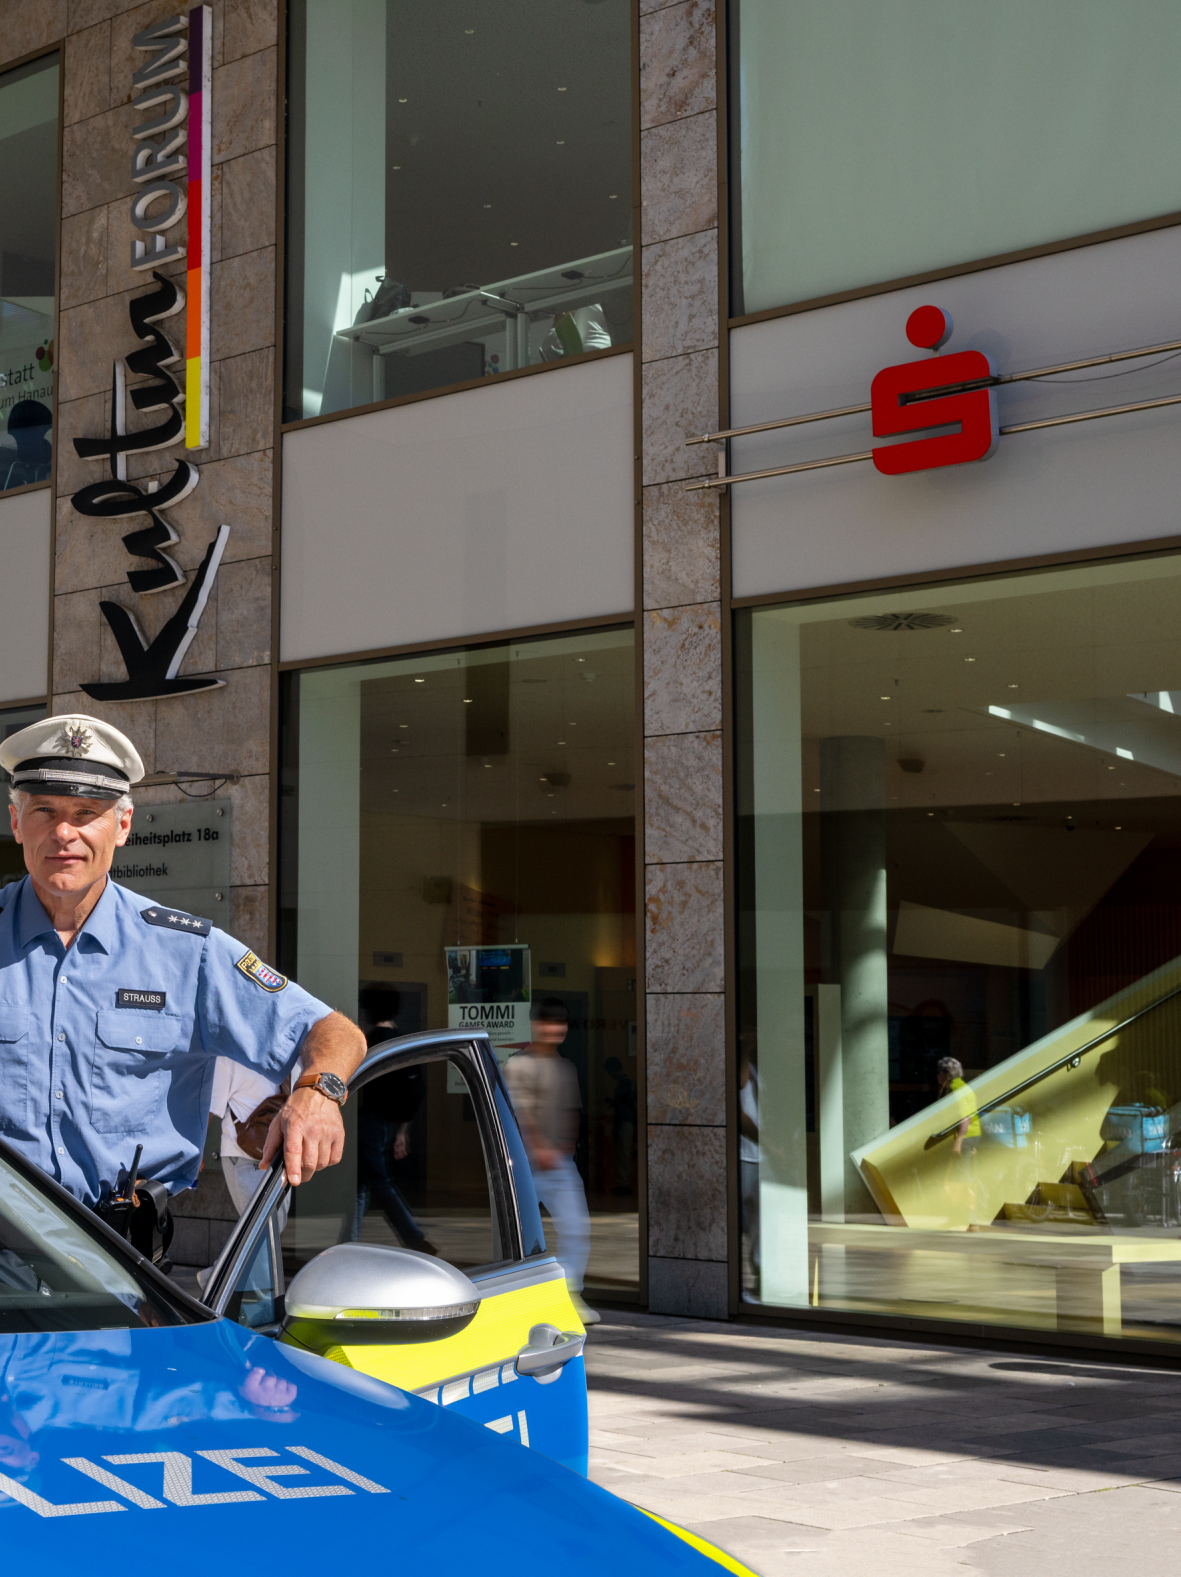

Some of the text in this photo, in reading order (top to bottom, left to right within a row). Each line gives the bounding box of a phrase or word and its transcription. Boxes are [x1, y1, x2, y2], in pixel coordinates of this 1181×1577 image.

[70, 15, 231, 701] Kultur FORUM
[19, 385, 53, 402] Hanau
[124, 828, 219, 847] eiheitsplatz 18a
[109, 863, 169, 879] dtbibliothek
[123, 992, 161, 1004] STRAUSS
[459, 1005, 515, 1020] TOMMI
[486, 1020, 515, 1029] AWARD
